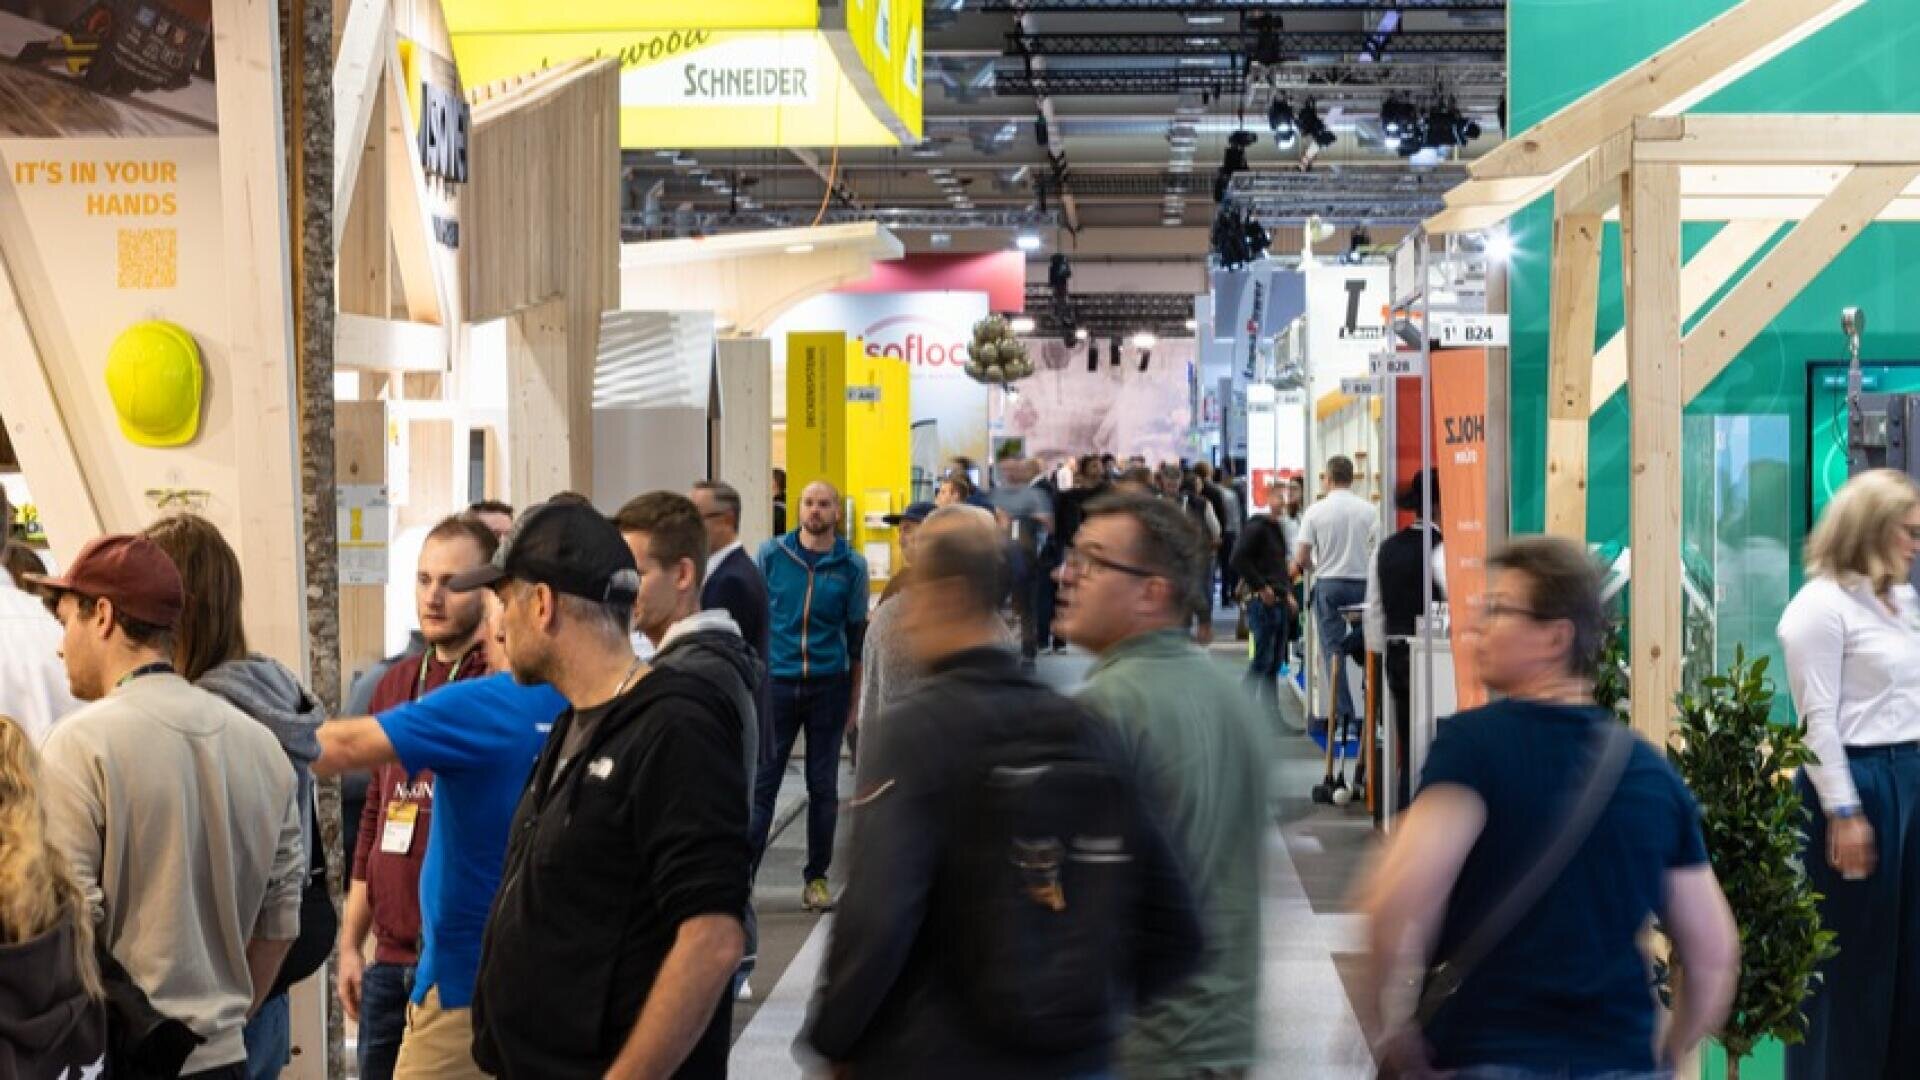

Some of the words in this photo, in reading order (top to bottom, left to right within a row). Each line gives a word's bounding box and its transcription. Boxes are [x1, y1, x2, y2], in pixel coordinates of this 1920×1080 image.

[684, 63, 808, 97] SCHNEIDER
[70, 161, 96, 184] IN
[104, 161, 178, 184] YOUR
[86, 192, 178, 216] HANDS
[1465, 325, 1494, 341] B24
[856, 333, 968, 367] sofloc
